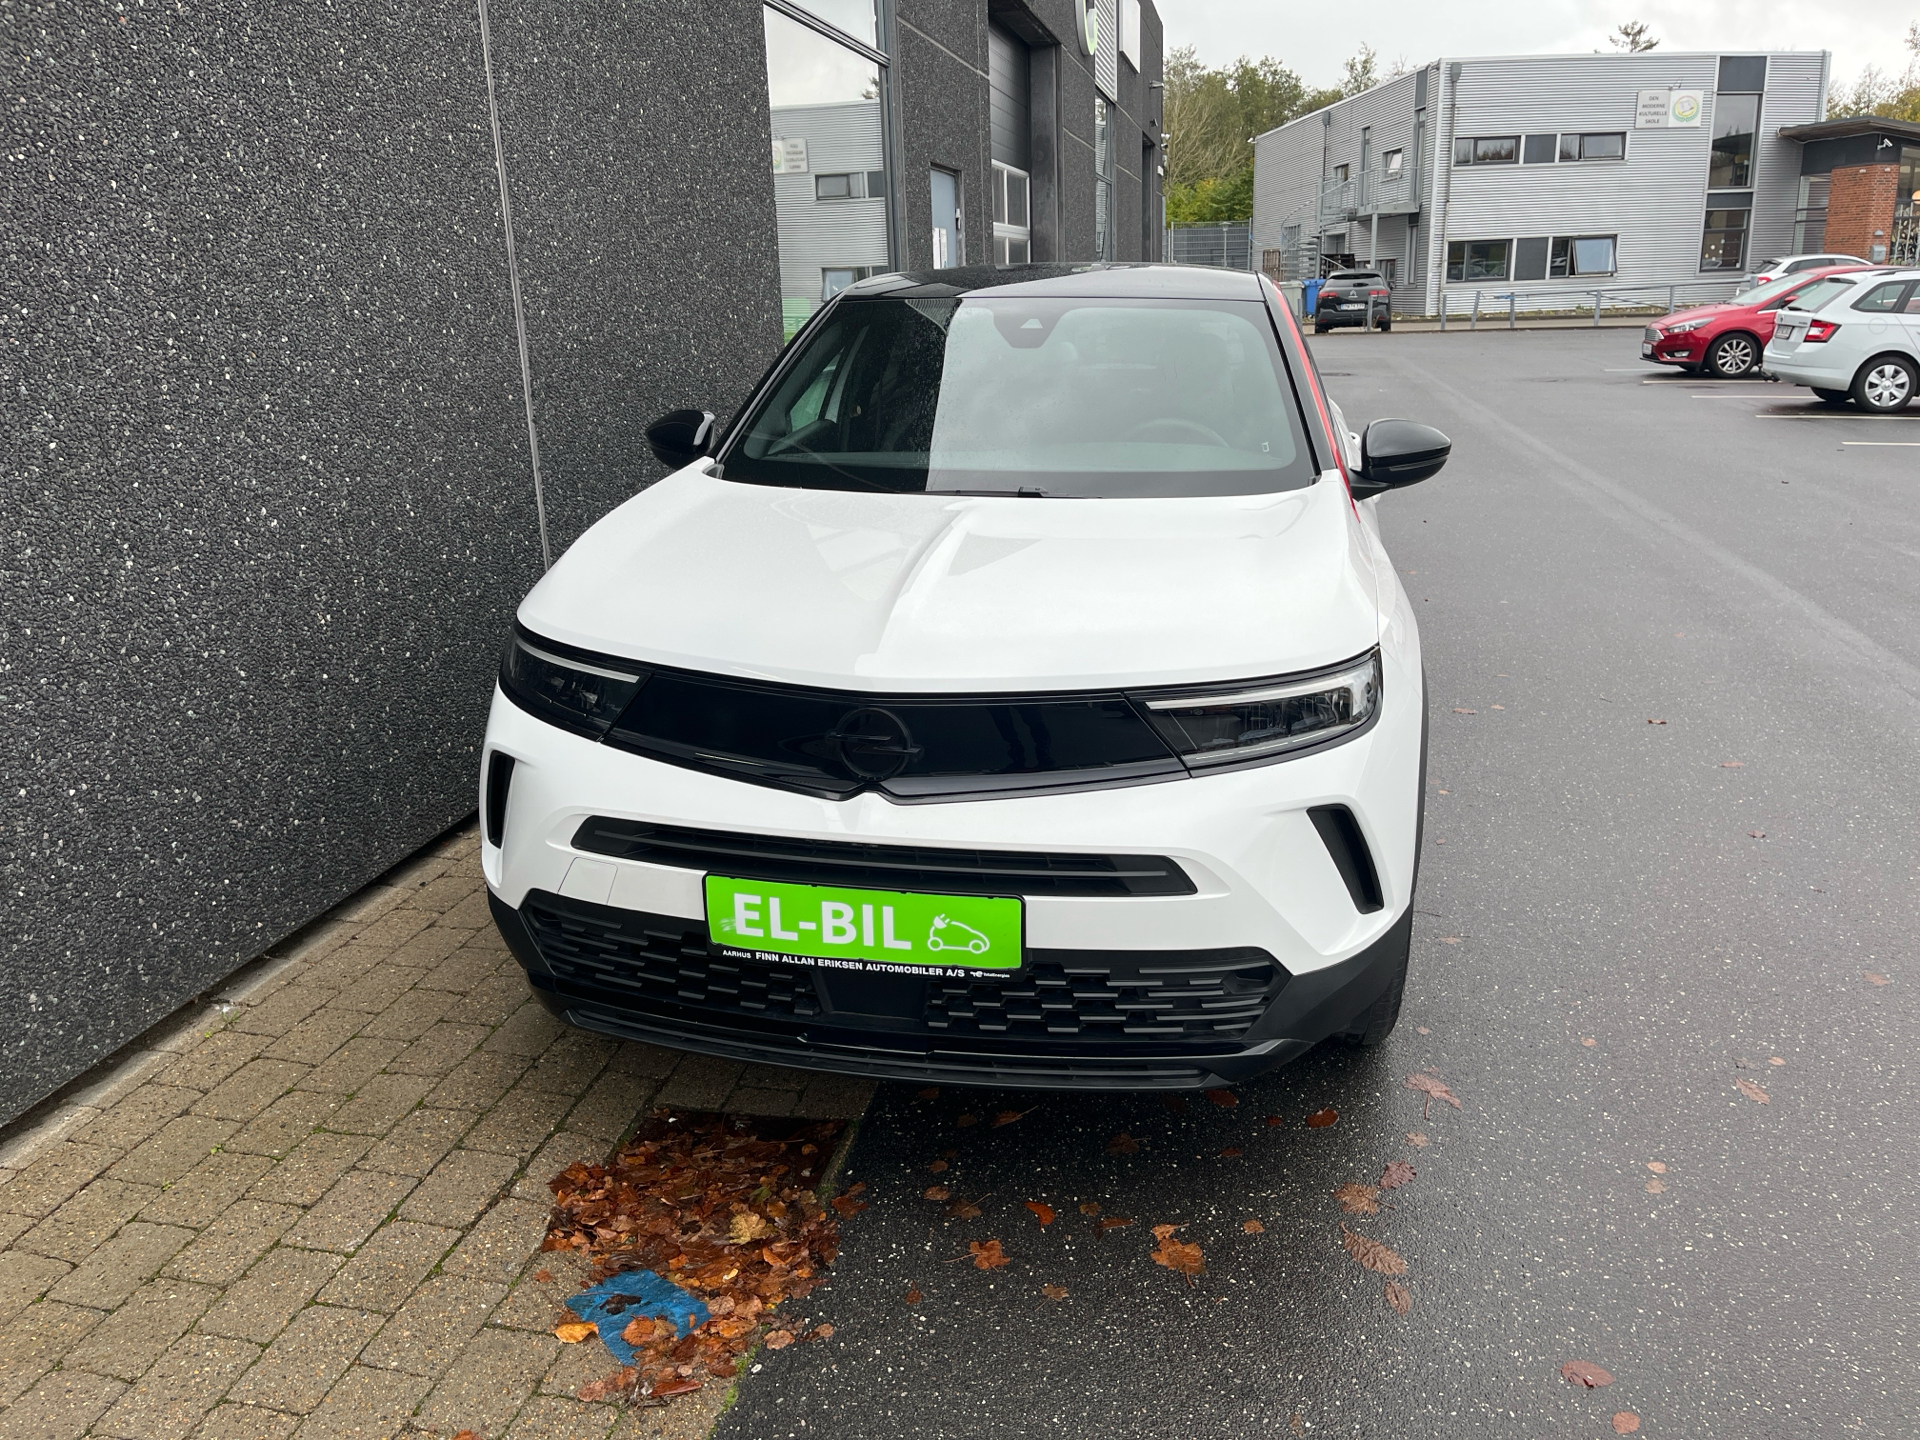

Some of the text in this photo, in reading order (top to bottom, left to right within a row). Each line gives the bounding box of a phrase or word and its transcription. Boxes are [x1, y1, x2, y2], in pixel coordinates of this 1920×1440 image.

[733, 893, 912, 951] EL-BIL
[722, 949, 751, 959] AARHUS
[755, 952, 779, 962] FINN
[782, 955, 815, 966] ALLAN
[817, 959, 863, 970] ERIKSEN
[866, 963, 943, 976] AUTOMOBILER
[946, 968, 966, 977] A/S
